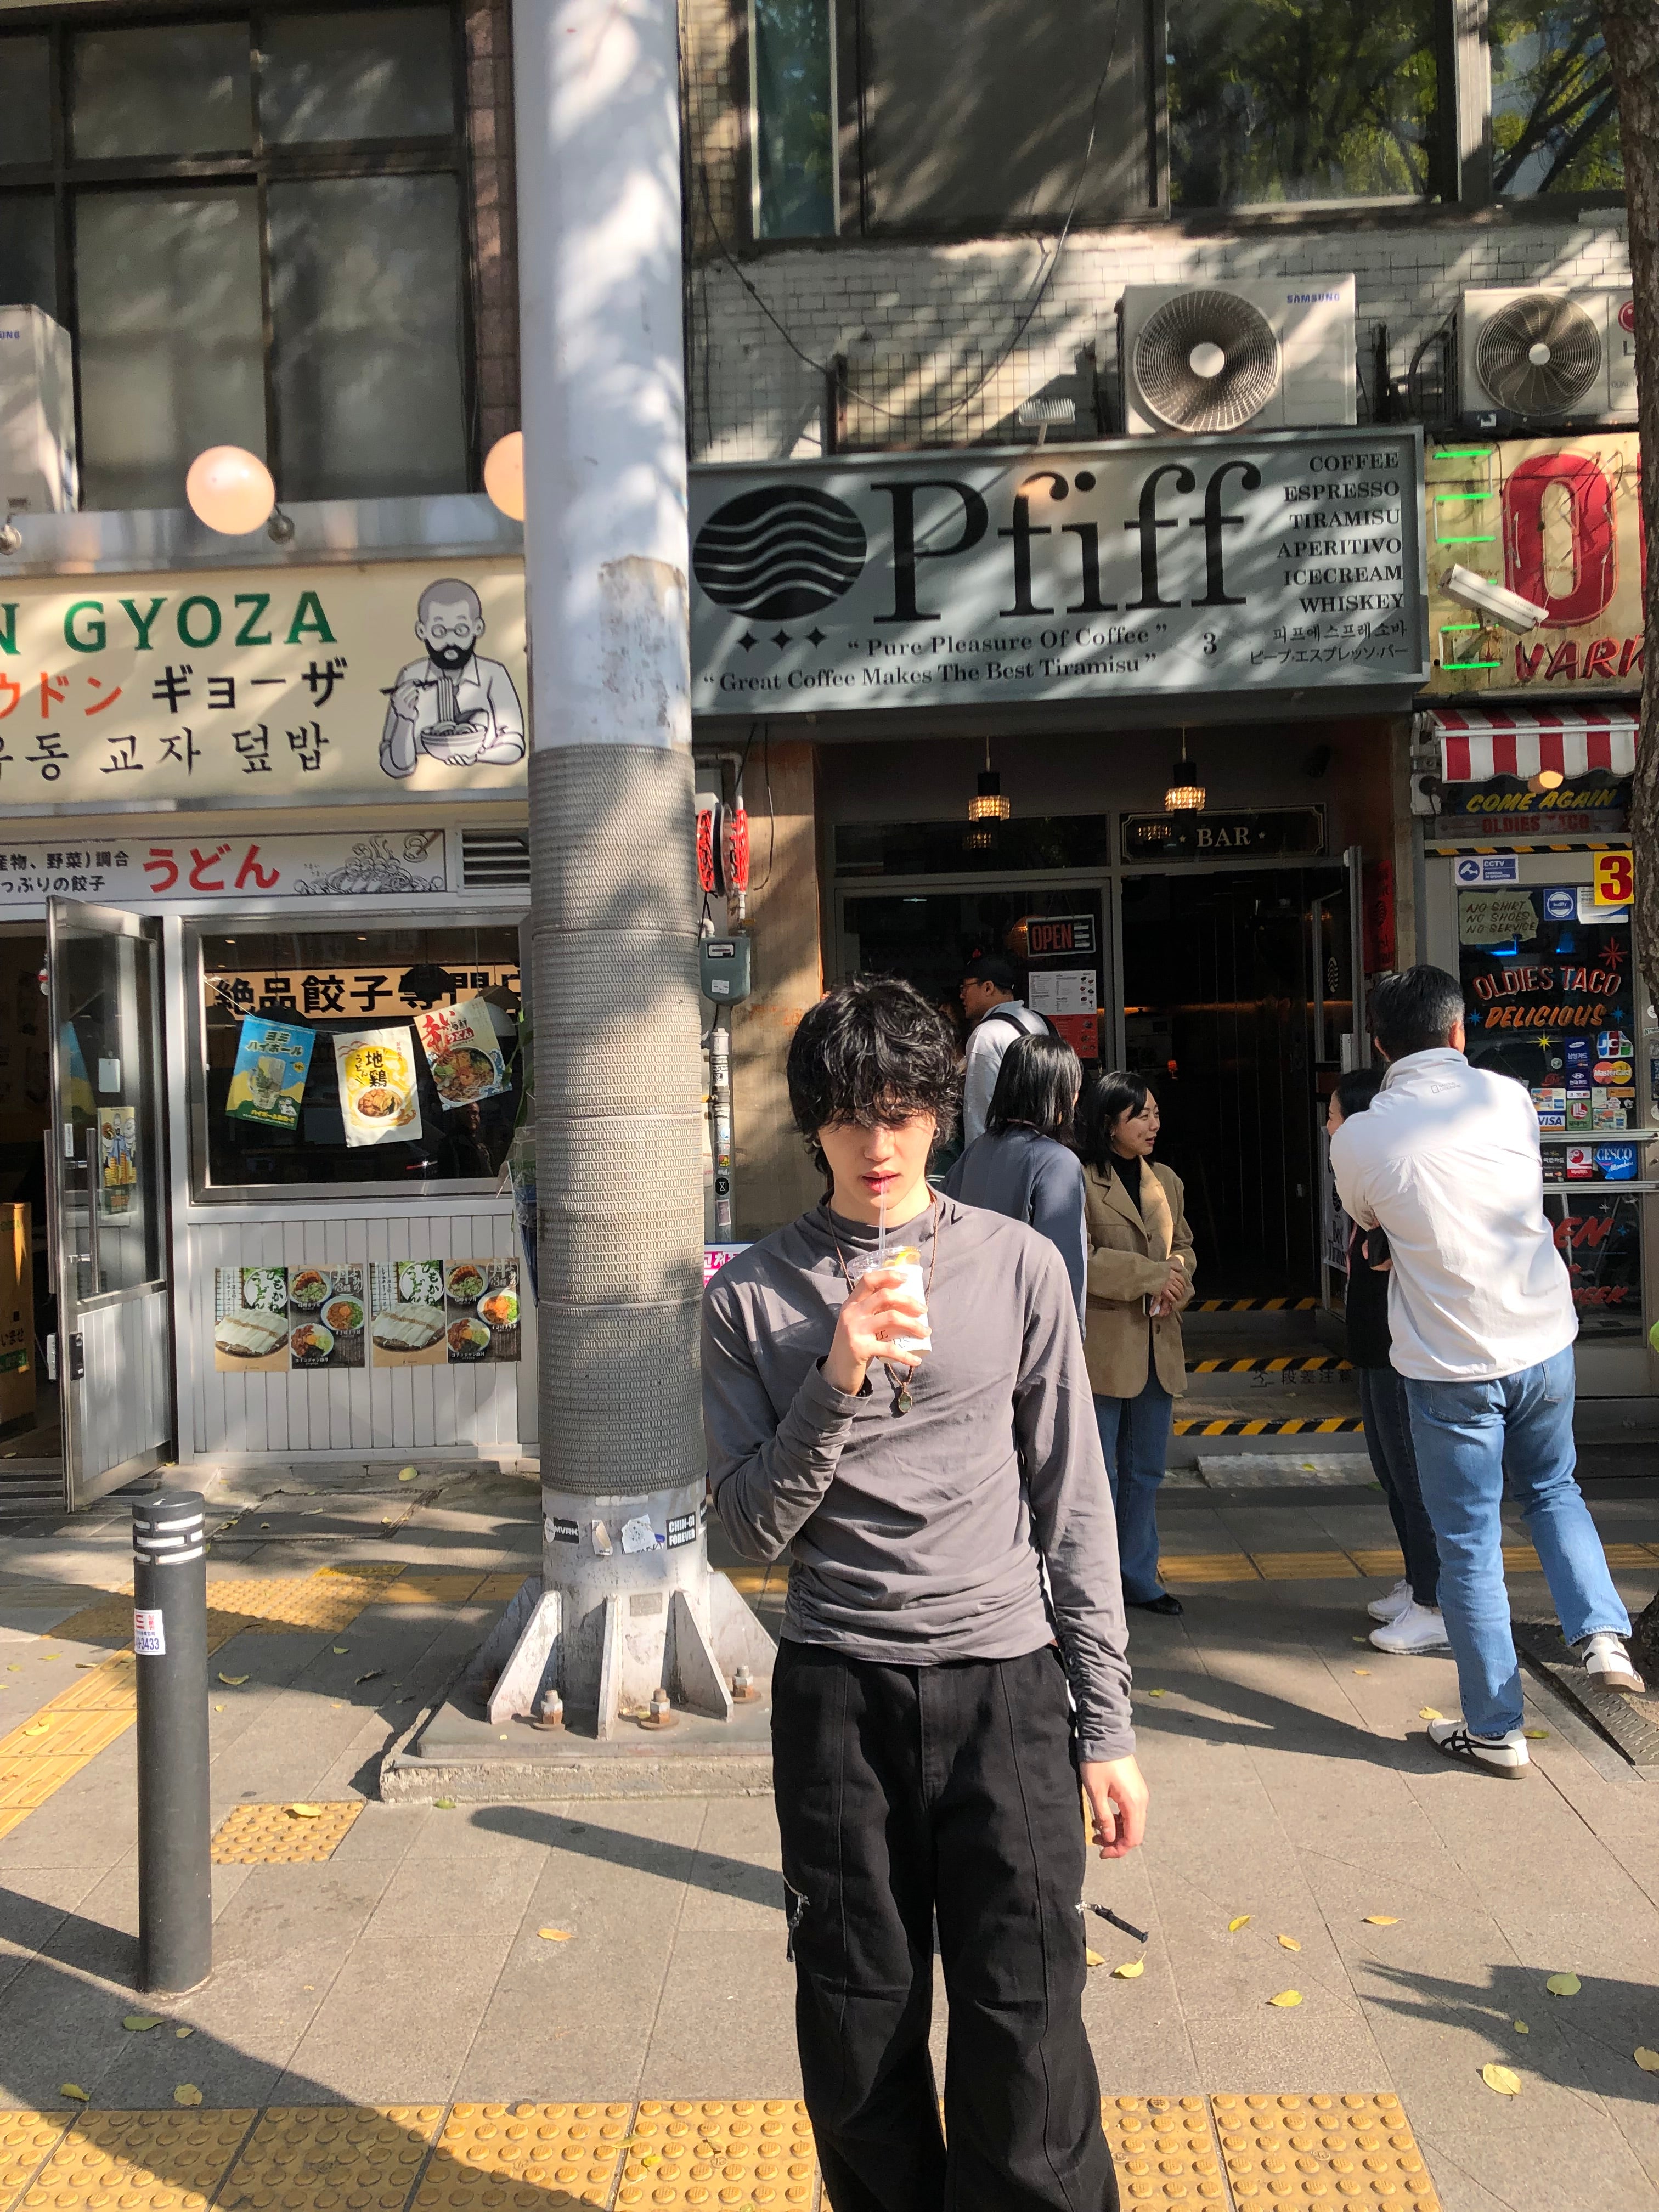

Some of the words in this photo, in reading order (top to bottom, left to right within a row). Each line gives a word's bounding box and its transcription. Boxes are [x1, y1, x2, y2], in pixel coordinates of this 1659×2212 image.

[1287, 293, 1339, 303] SAMSUNG
[1309, 453, 1399, 472] COFFEE
[1284, 481, 1400, 501] ESPRESSO
[1289, 509, 1401, 529] TIRAMISU
[870, 460, 1261, 624] Piff
[1277, 537, 1402, 558] APERITIVO
[1283, 565, 1404, 586] ICECREAM
[1300, 593, 1404, 614] WHISKEY
[64, 590, 338, 653] GYOZA
[866, 638, 922, 657] Pure
[932, 635, 1032, 655] Pleasure
[1040, 629, 1070, 650] Of
[1075, 625, 1150, 647] Coffee
[151, 657, 348, 714] ギョーザ
[720, 671, 782, 693] Great
[788, 668, 855, 690] Coffee
[862, 666, 933, 686] Makes
[937, 663, 980, 683] The
[987, 661, 1035, 680] Best
[1038, 657, 1140, 679] Tiramisu
[99, 726, 201, 776] 교자
[231, 720, 330, 775] 덮밥
[1466, 792, 1537, 813] COME
[1538, 789, 1617, 810] AGAIN
[1482, 814, 1541, 834] OLDIES
[1196, 826, 1251, 848] BAR
[143, 844, 281, 893] うどん
[1599, 855, 1634, 901] 3
[1466, 903, 1487, 913] NO
[1491, 901, 1526, 911] SHIRT
[1466, 913, 1485, 923] NO
[1490, 911, 1530, 922] SHOES
[1032, 923, 1073, 951] OPEN
[1466, 924, 1485, 934] NO
[1489, 921, 1536, 933] SERVICE
[1472, 966, 1553, 1000] OLDIES
[1560, 966, 1622, 997] TACO
[1485, 1003, 1607, 1029] DELICIOUS
[1538, 1116, 1562, 1126] VISA
[1596, 1148, 1633, 1161] CESCO
[1547, 1215, 1615, 1248] EN
[555, 1526, 579, 1537] MVRK
[668, 1519, 695, 1533] CHIN-GI
[668, 1528, 696, 1547] FOREVER
